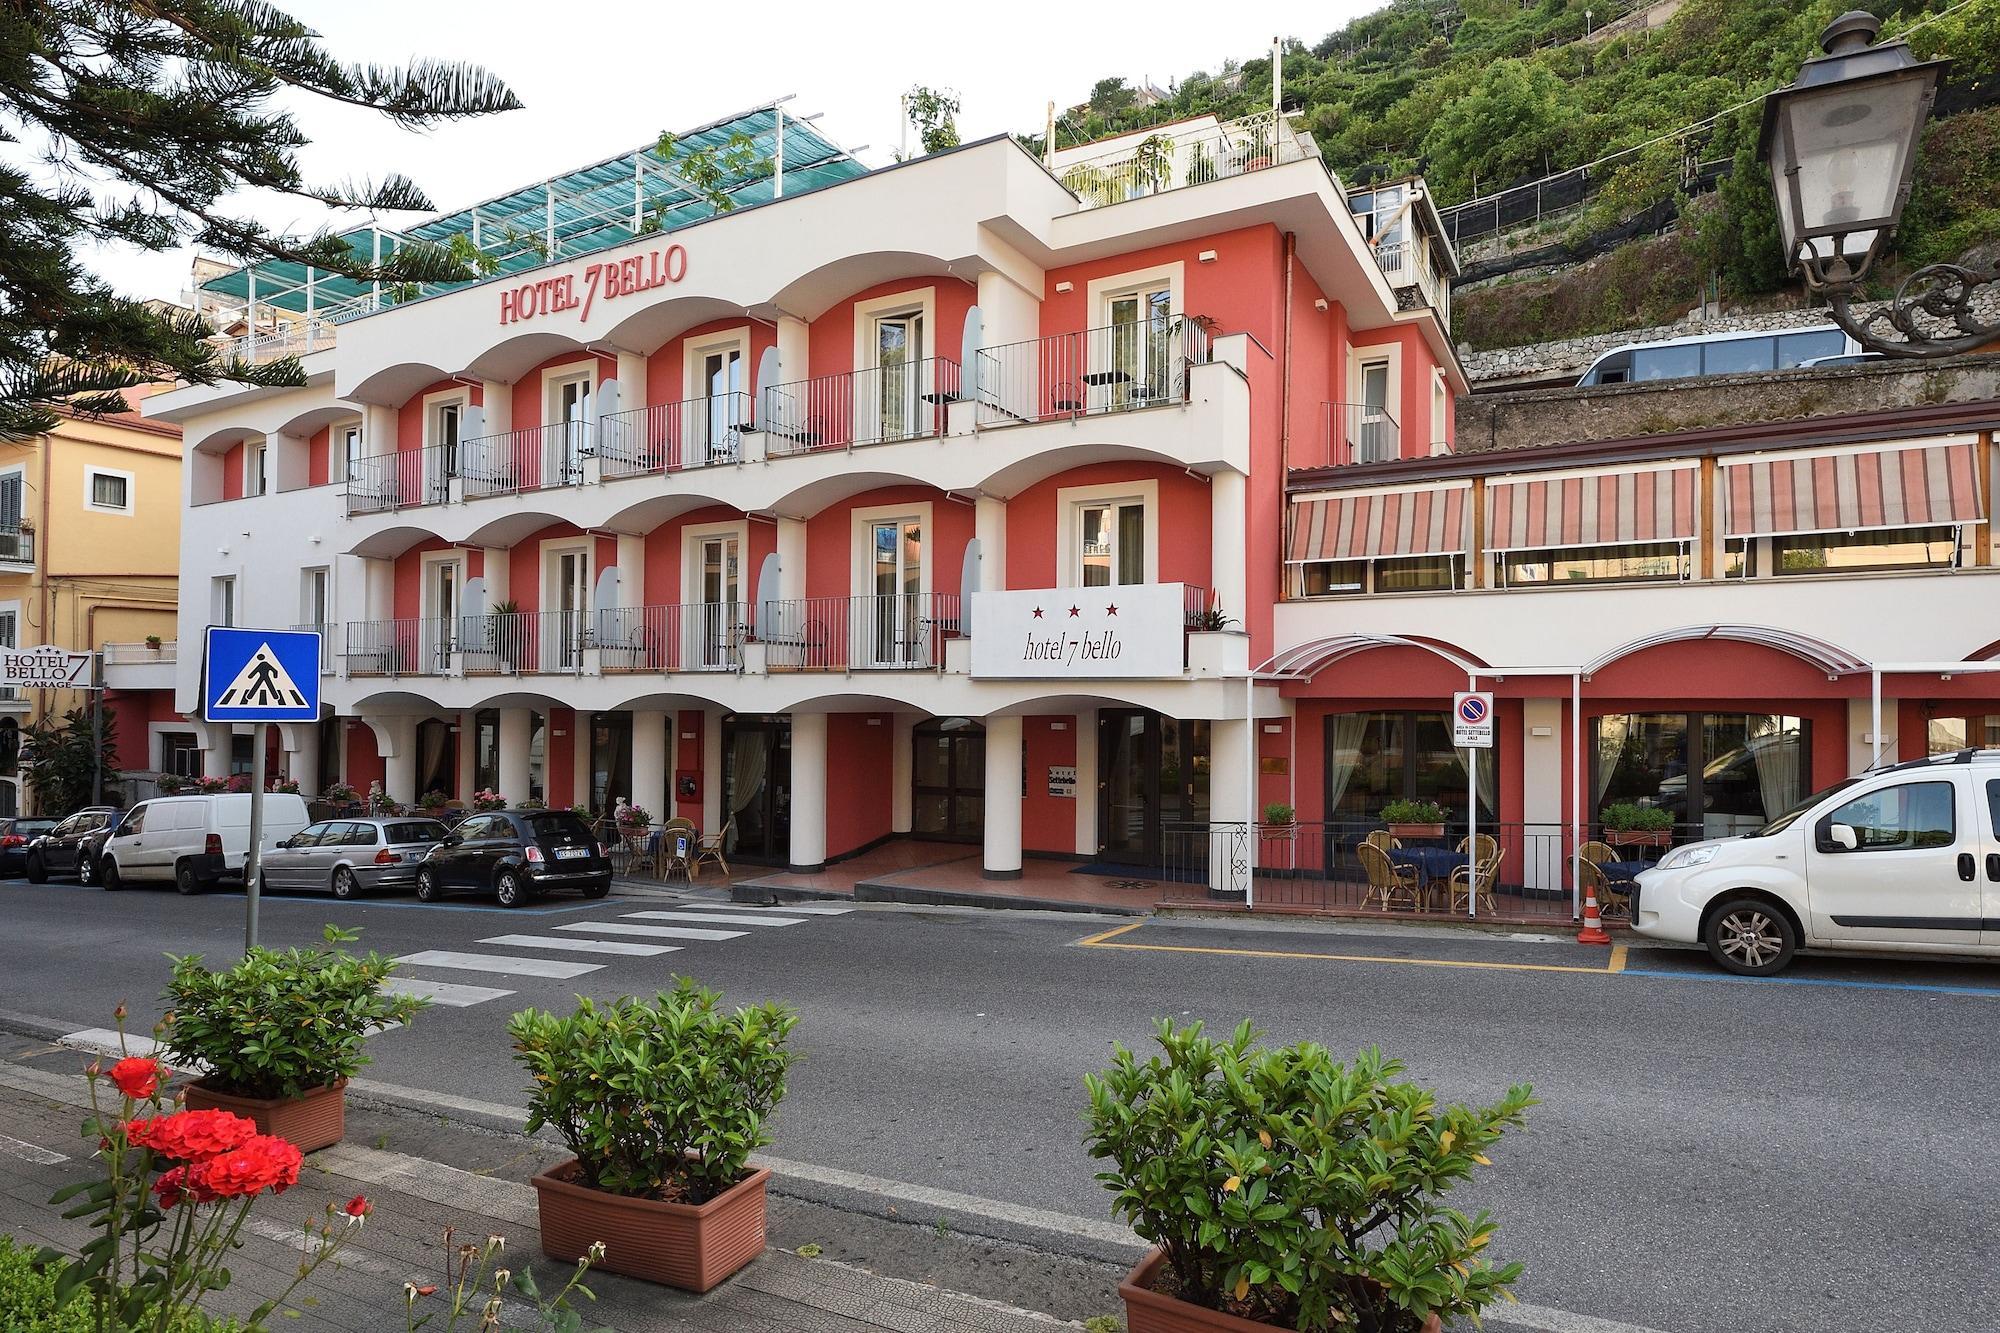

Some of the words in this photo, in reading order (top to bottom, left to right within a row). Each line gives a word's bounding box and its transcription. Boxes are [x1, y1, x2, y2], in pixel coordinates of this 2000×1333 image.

[500, 274, 579, 325] HOTEL
[580, 264, 602, 322] 7
[604, 244, 687, 299] BELLO
[1023, 631, 1066, 660] hotel
[1067, 641, 1079, 667] 7
[1081, 630, 1122, 659] bello
[4, 655, 68, 668] HOTEL
[68, 655, 90, 681] 7
[6, 667, 66, 679] BELLO
